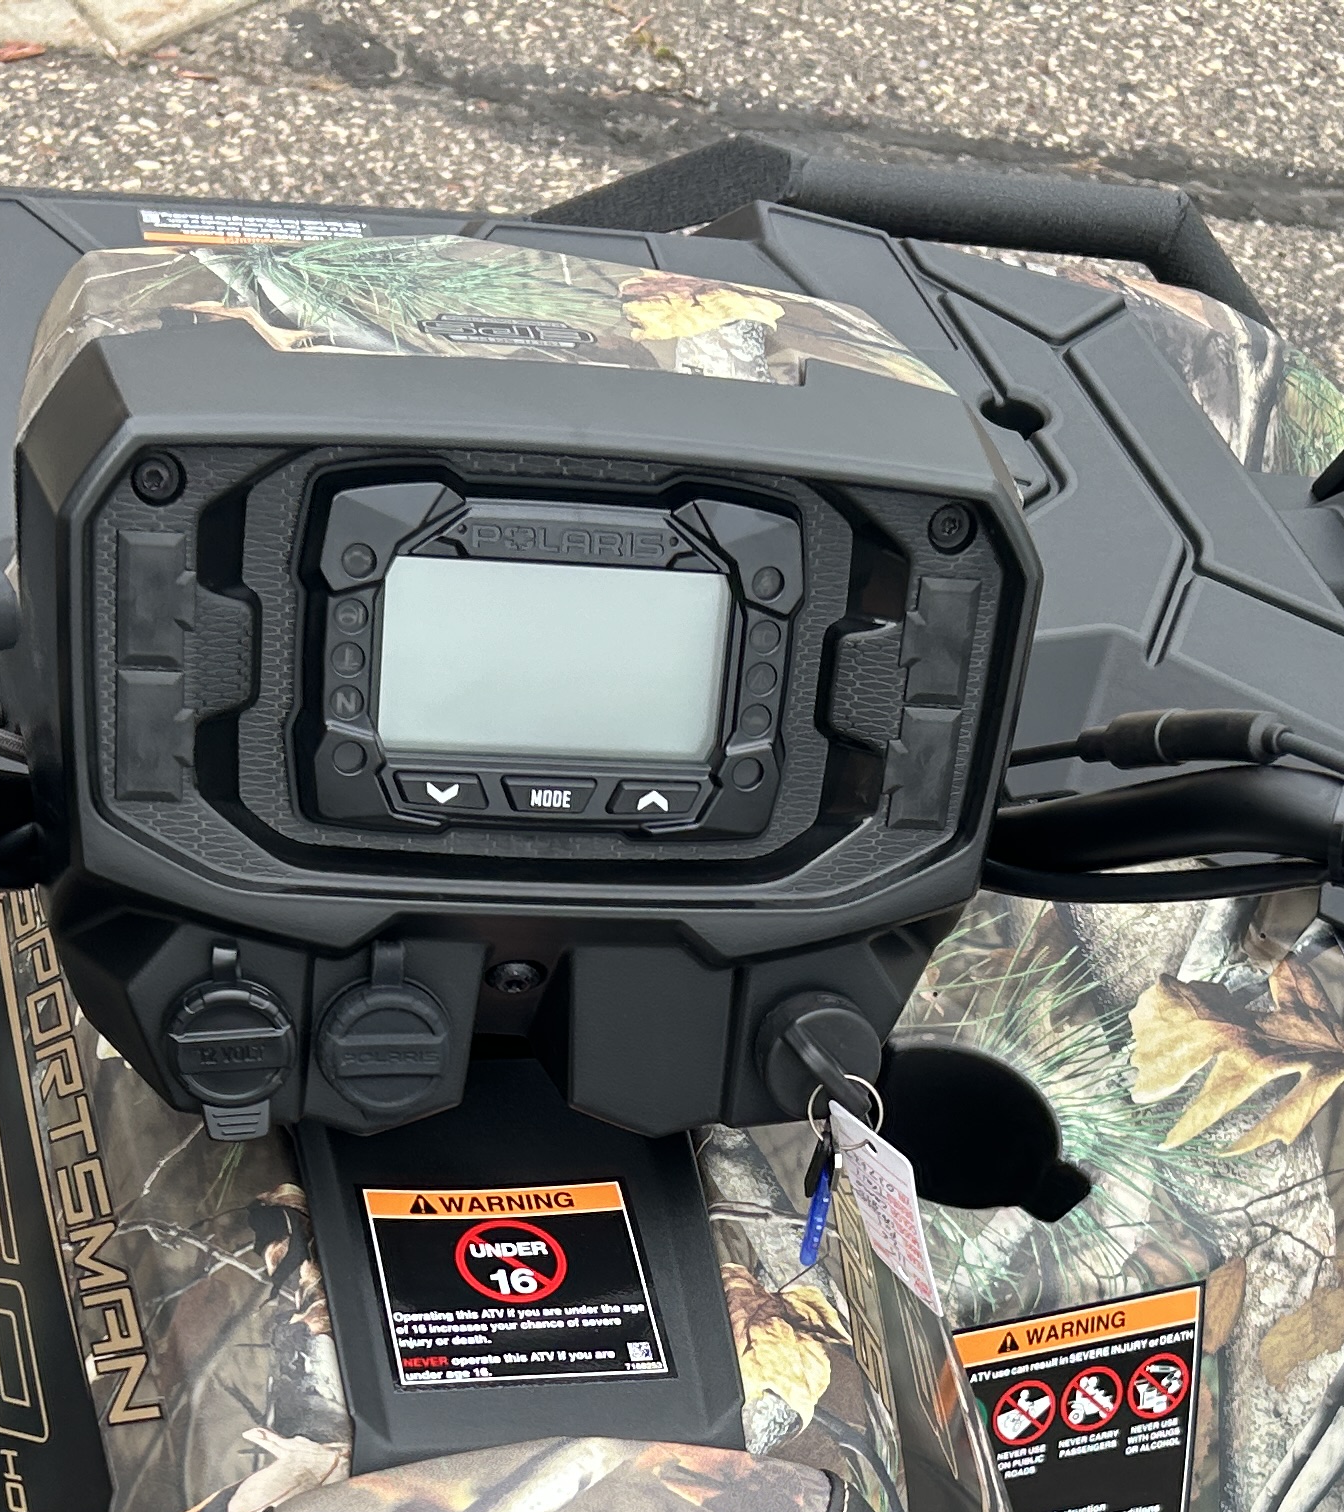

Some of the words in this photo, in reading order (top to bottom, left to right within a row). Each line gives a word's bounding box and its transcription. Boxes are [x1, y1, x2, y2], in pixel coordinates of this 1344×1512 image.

[471, 522, 666, 557] POLARIS
[530, 788, 573, 809] MODE
[9, 887, 164, 1425] SPORTSMAN
[438, 1192, 574, 1212] WARNING
[468, 1241, 548, 1258] UNDER
[487, 1267, 539, 1294] 16
[391, 1309, 454, 1323] Operating
[454, 1309, 479, 1319] this
[479, 1308, 505, 1318] ATV
[505, 1308, 516, 1317] if
[516, 1309, 541, 1318] you
[541, 1307, 563, 1316] are
[562, 1304, 600, 1315] under
[599, 1303, 621, 1313] the
[621, 1303, 646, 1314] age
[394, 1324, 409, 1334] of
[410, 1324, 427, 1334] 16
[427, 1321, 489, 1333] increases
[489, 1322, 519, 1332] your
[518, 1318, 565, 1329] chance
[565, 1317, 580, 1327] of
[580, 1317, 623, 1326] severe
[1025, 1310, 1126, 1345] WARNING
[397, 1337, 434, 1349] injury
[434, 1337, 450, 1346] or
[402, 1356, 448, 1367] NEVER
[449, 1354, 502, 1367] operate
[502, 1352, 528, 1363] this
[528, 1351, 556, 1362] ATV
[556, 1351, 567, 1360] if
[567, 1351, 593, 1361] you
[593, 1350, 616, 1358] are
[969, 1370, 991, 1383] ATV
[991, 1368, 1010, 1379] use
[1010, 1364, 1030, 1375] can
[1029, 1357, 1059, 1371] result
[1068, 1345, 1111, 1364] SEVERE
[1109, 1338, 1148, 1355] INJURY
[1157, 1328, 1195, 1345] DEATH
[403, 1370, 445, 1382] under
[443, 1369, 473, 1380] age
[1129, 1420, 1160, 1434] NEVER
[1159, 1417, 1179, 1428] USE
[1058, 1435, 1088, 1448] NEVER
[1088, 1429, 1119, 1442] CARRY
[1126, 1432, 1150, 1444] WITH
[1149, 1426, 1181, 1440] DRUGS
[1139, 1436, 1181, 1452] ALCOHOL
[996, 1447, 1026, 1461] NEVER
[1027, 1443, 1046, 1455] USE
[1058, 1439, 1118, 1458] PASSENGERS
[1012, 1454, 1044, 1467] PUBLIC
[1004, 1465, 1036, 1479] ROADS
